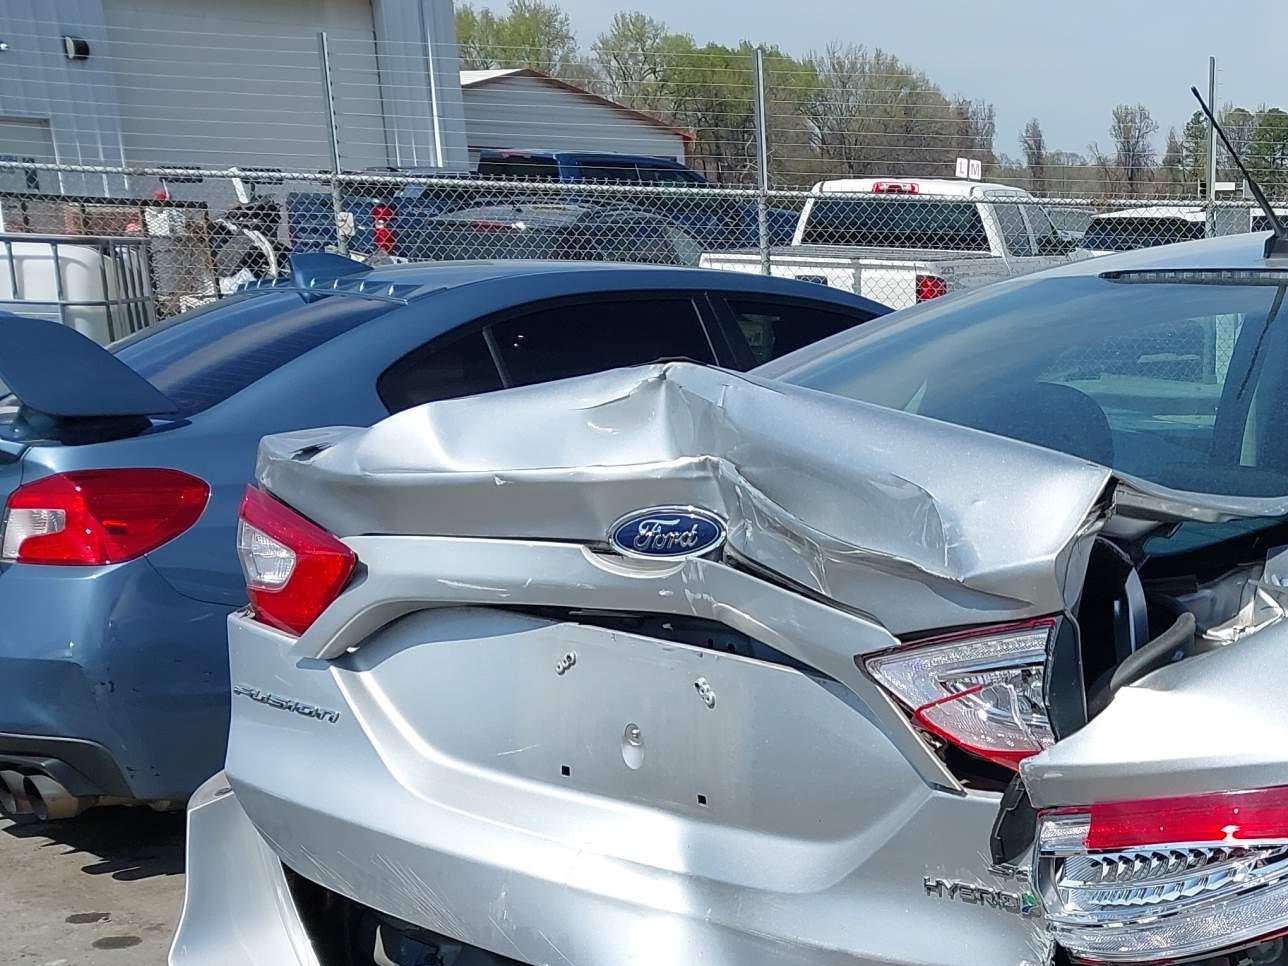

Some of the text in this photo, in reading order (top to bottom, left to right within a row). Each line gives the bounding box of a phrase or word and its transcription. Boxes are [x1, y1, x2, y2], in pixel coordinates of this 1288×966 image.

[633, 518, 699, 550] Ford
[232, 685, 341, 724] FUSION
[923, 876, 1021, 914] HYBRID
